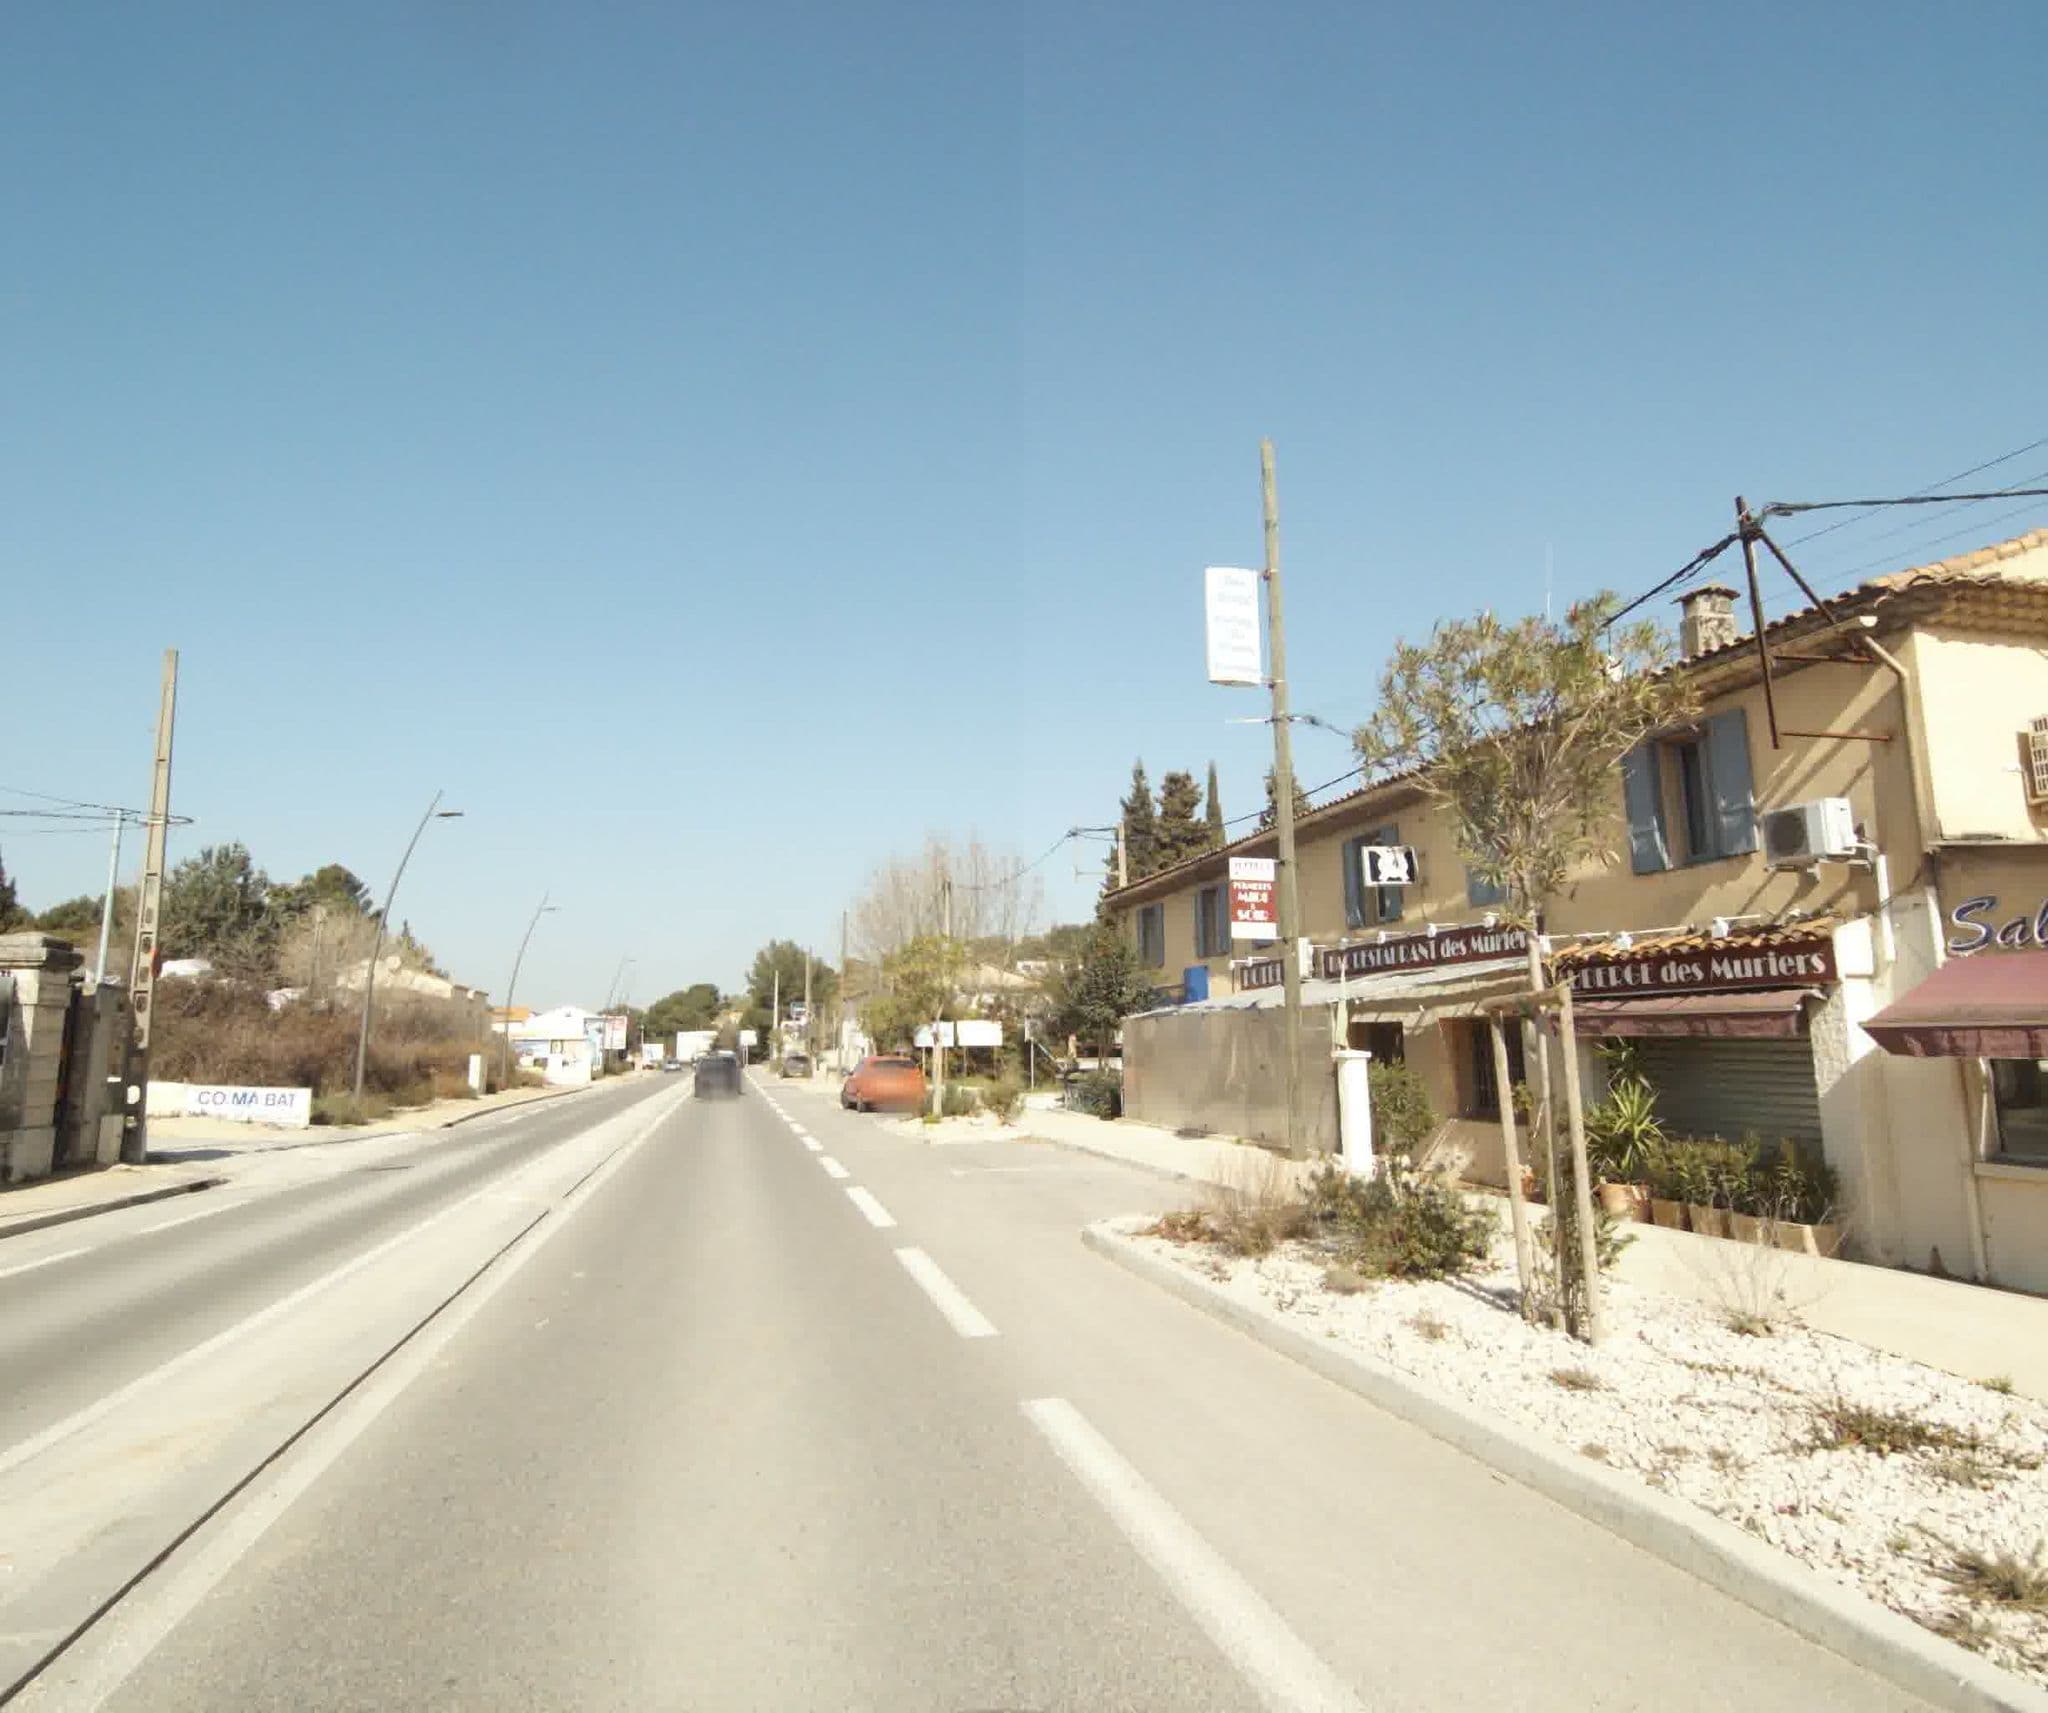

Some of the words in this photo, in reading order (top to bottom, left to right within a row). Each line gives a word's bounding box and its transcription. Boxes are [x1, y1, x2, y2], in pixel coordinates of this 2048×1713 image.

[1441, 936, 1467, 958] des
[1660, 960, 1705, 984] des
[1711, 951, 1827, 981] Muriers
[265, 1092, 296, 1107] BAT
